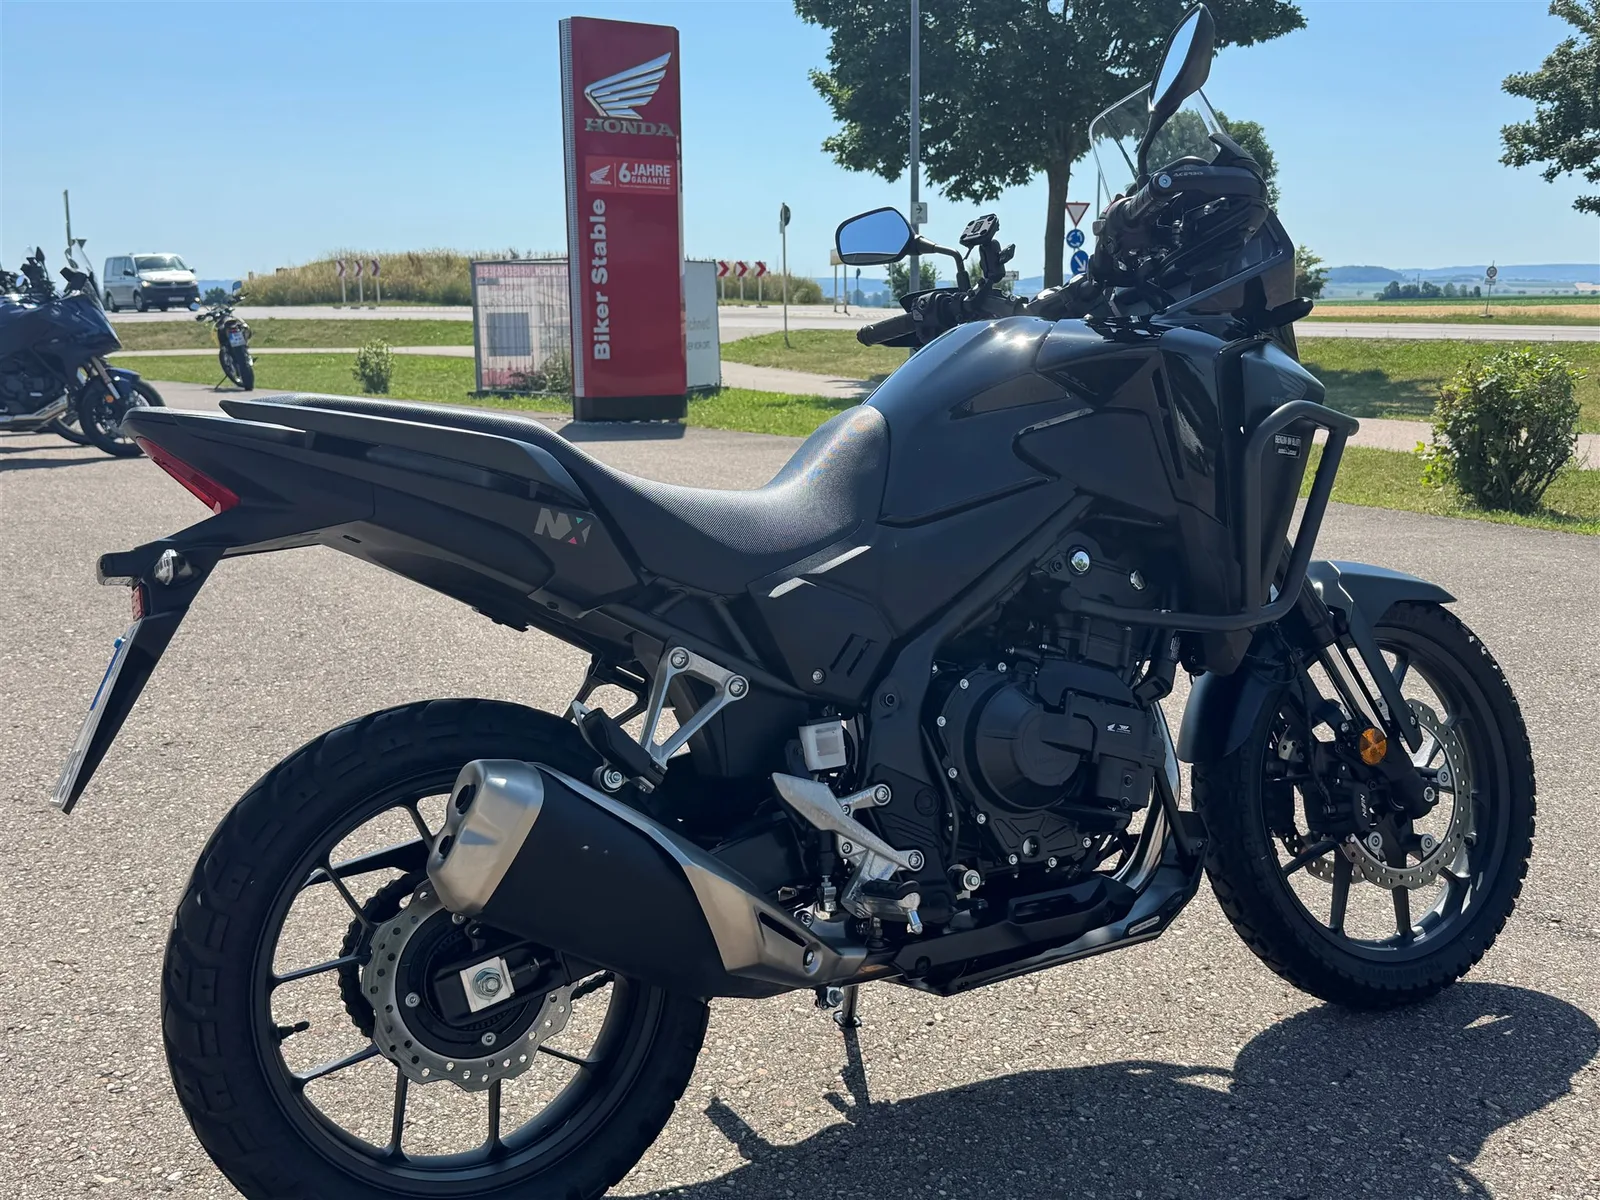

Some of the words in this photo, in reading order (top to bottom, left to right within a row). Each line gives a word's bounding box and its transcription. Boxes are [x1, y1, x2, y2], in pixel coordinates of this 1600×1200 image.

[584, 117, 675, 137] HONDA
[618, 162, 631, 183] 6
[631, 175, 671, 185] GARANTIE
[589, 198, 609, 285] Stable
[593, 291, 611, 360] Biker
